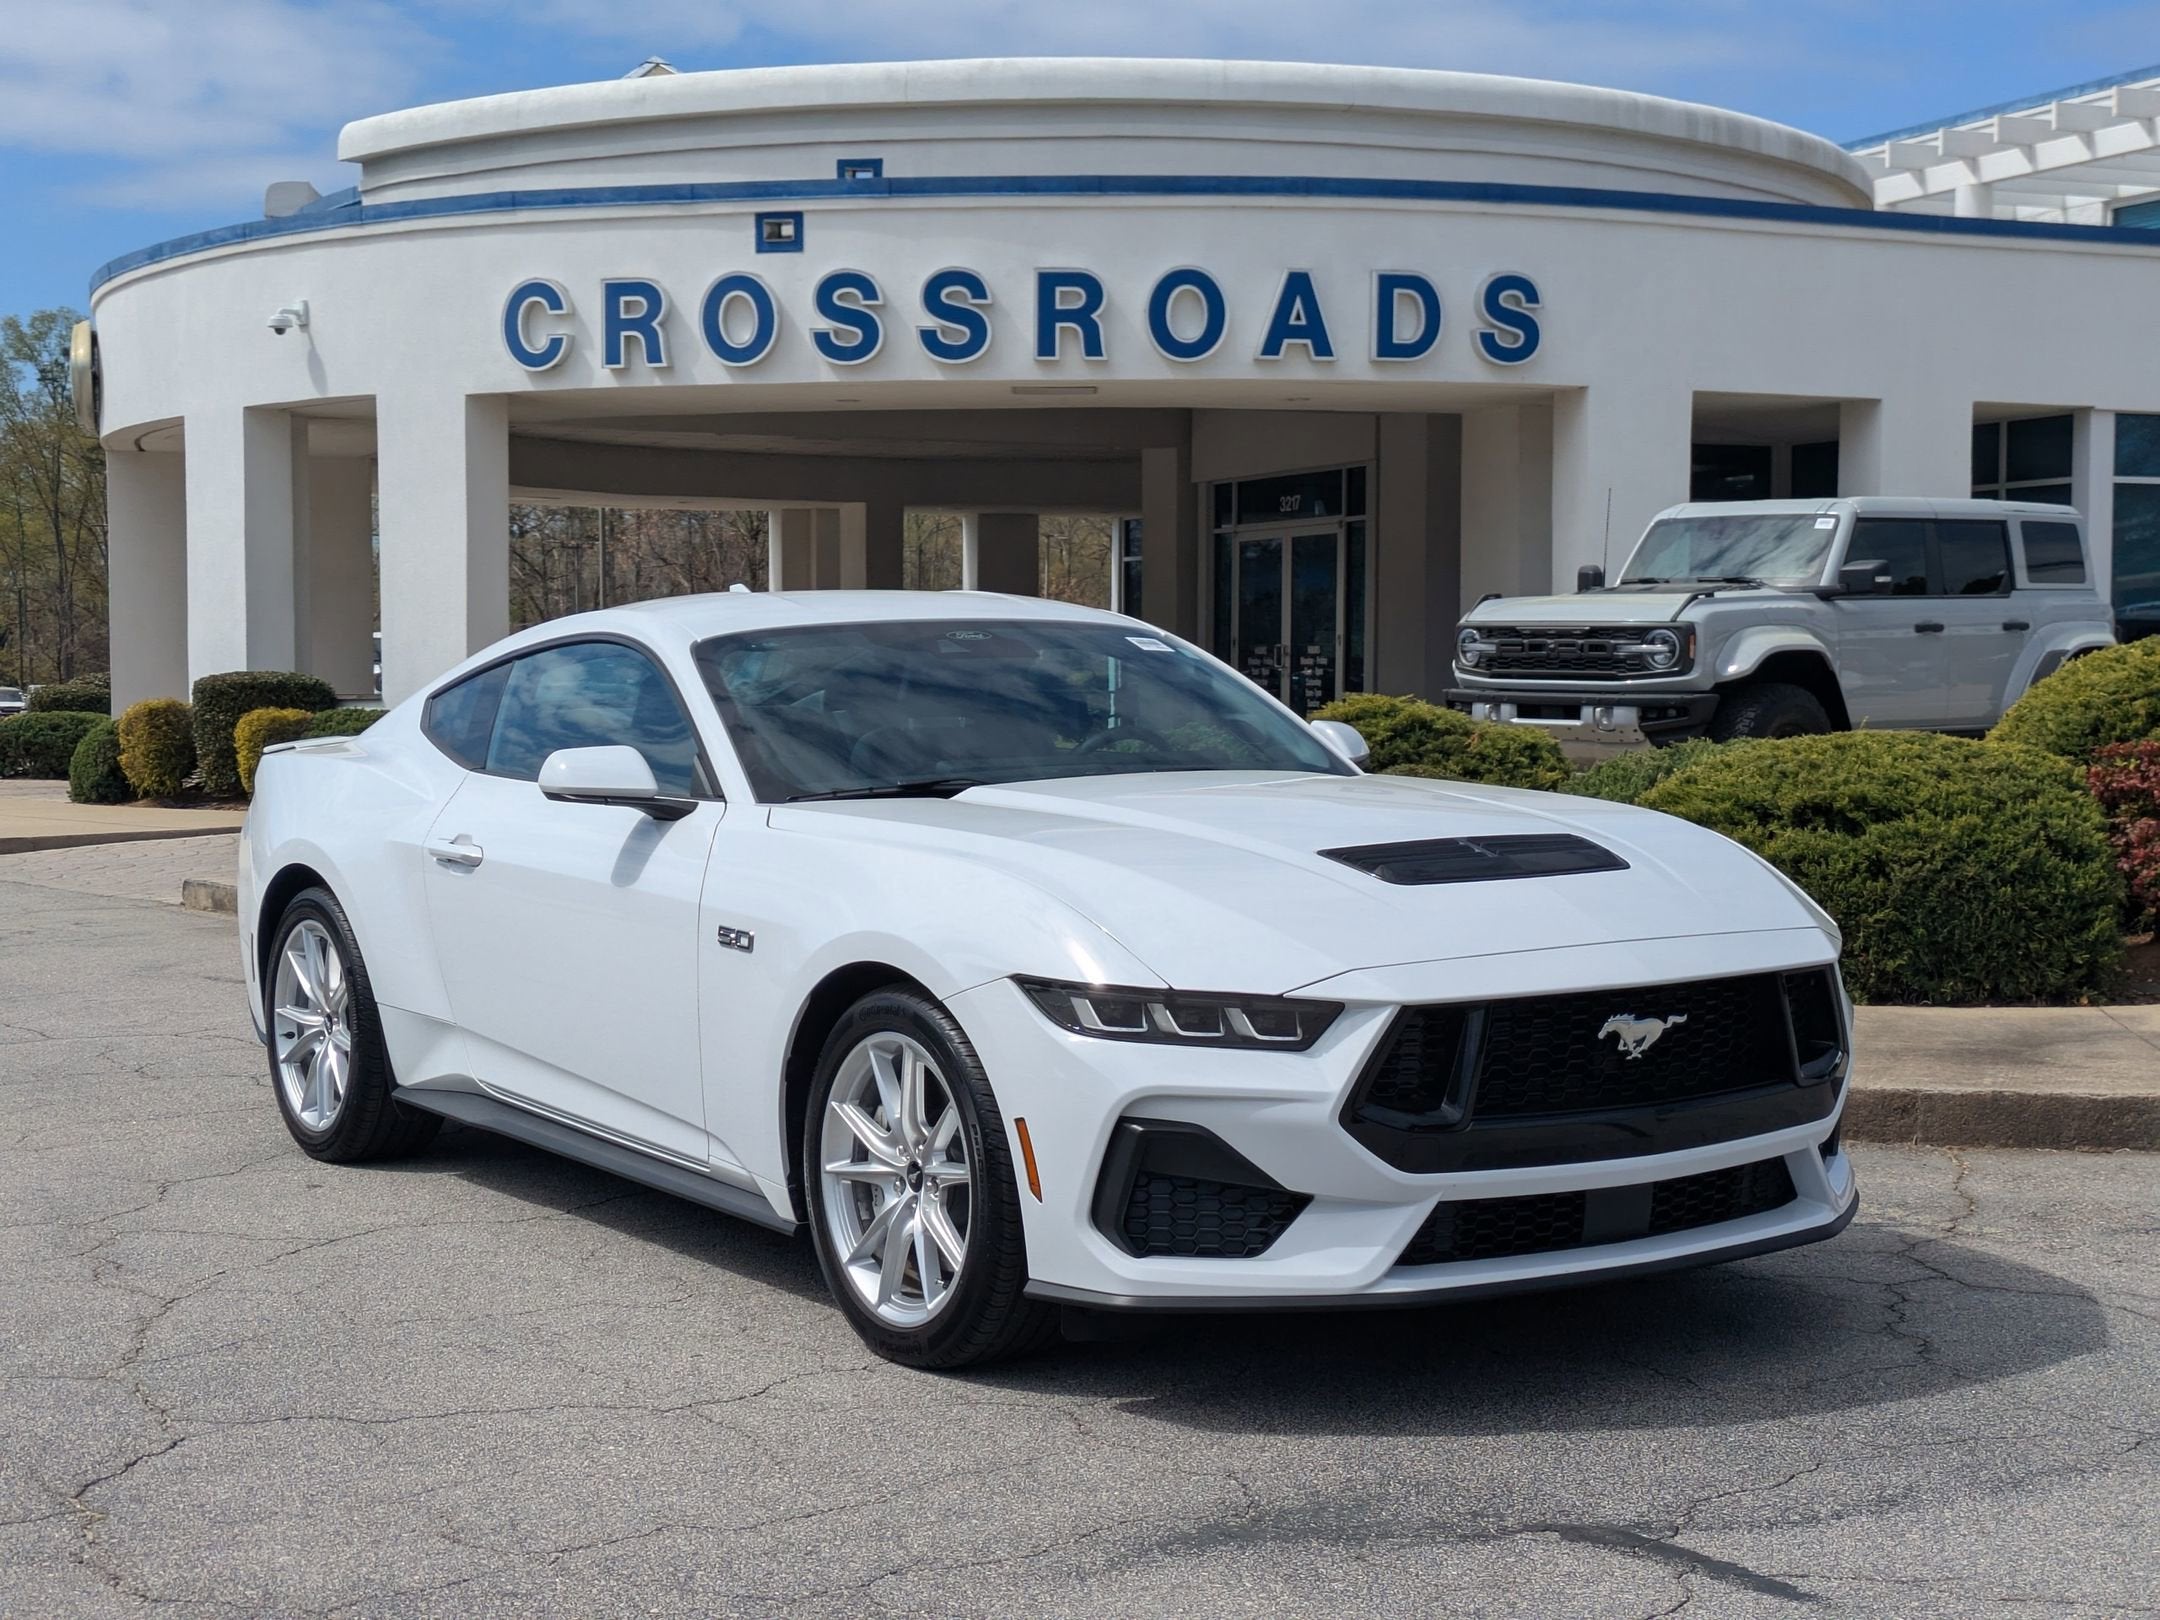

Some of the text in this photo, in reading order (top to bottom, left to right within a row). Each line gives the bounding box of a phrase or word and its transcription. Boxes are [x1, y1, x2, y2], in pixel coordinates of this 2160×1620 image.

[503, 268, 1542, 371] CROSSROADS
[1279, 494, 1301, 513] 3217
[954, 630, 984, 641] Ford
[1495, 638, 1613, 658] FORD
